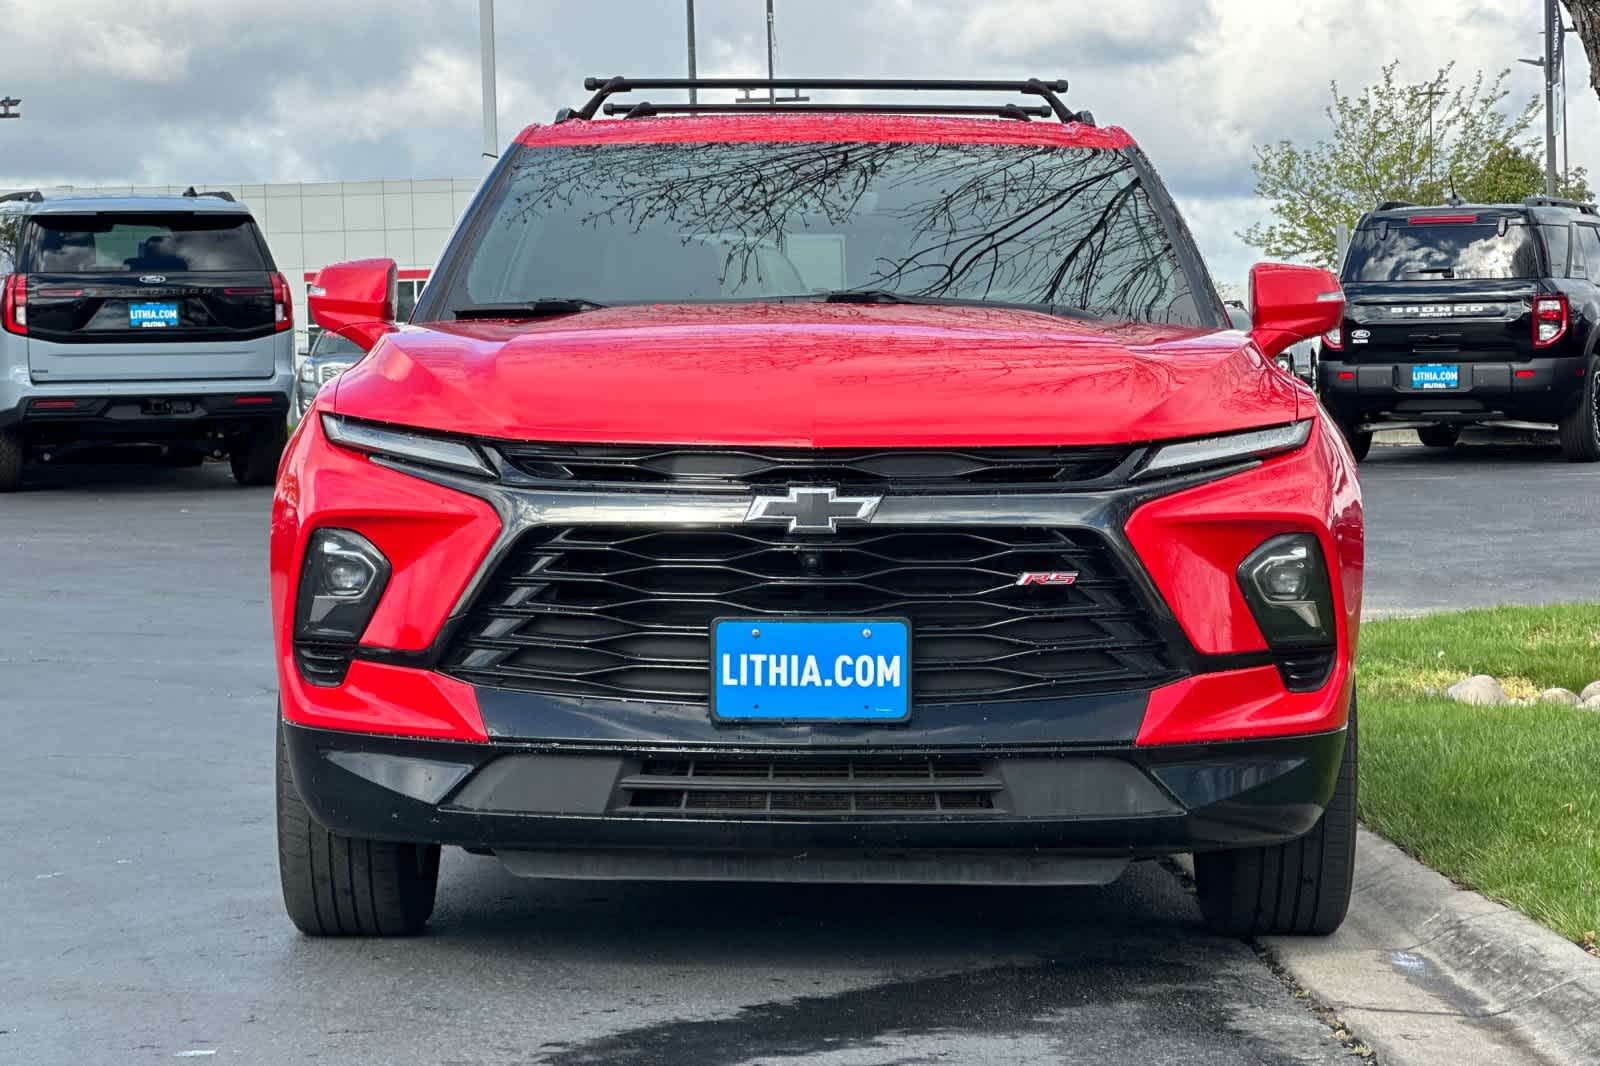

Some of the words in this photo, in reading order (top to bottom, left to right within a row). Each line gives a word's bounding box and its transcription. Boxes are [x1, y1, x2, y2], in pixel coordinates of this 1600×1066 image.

[130, 309, 177, 319] LITHIA.COM
[1391, 305, 1484, 314] BRONCO
[1412, 371, 1458, 381] LITHIA.COM
[1016, 571, 1079, 586] RS
[722, 653, 901, 687] LITHIA.COM
